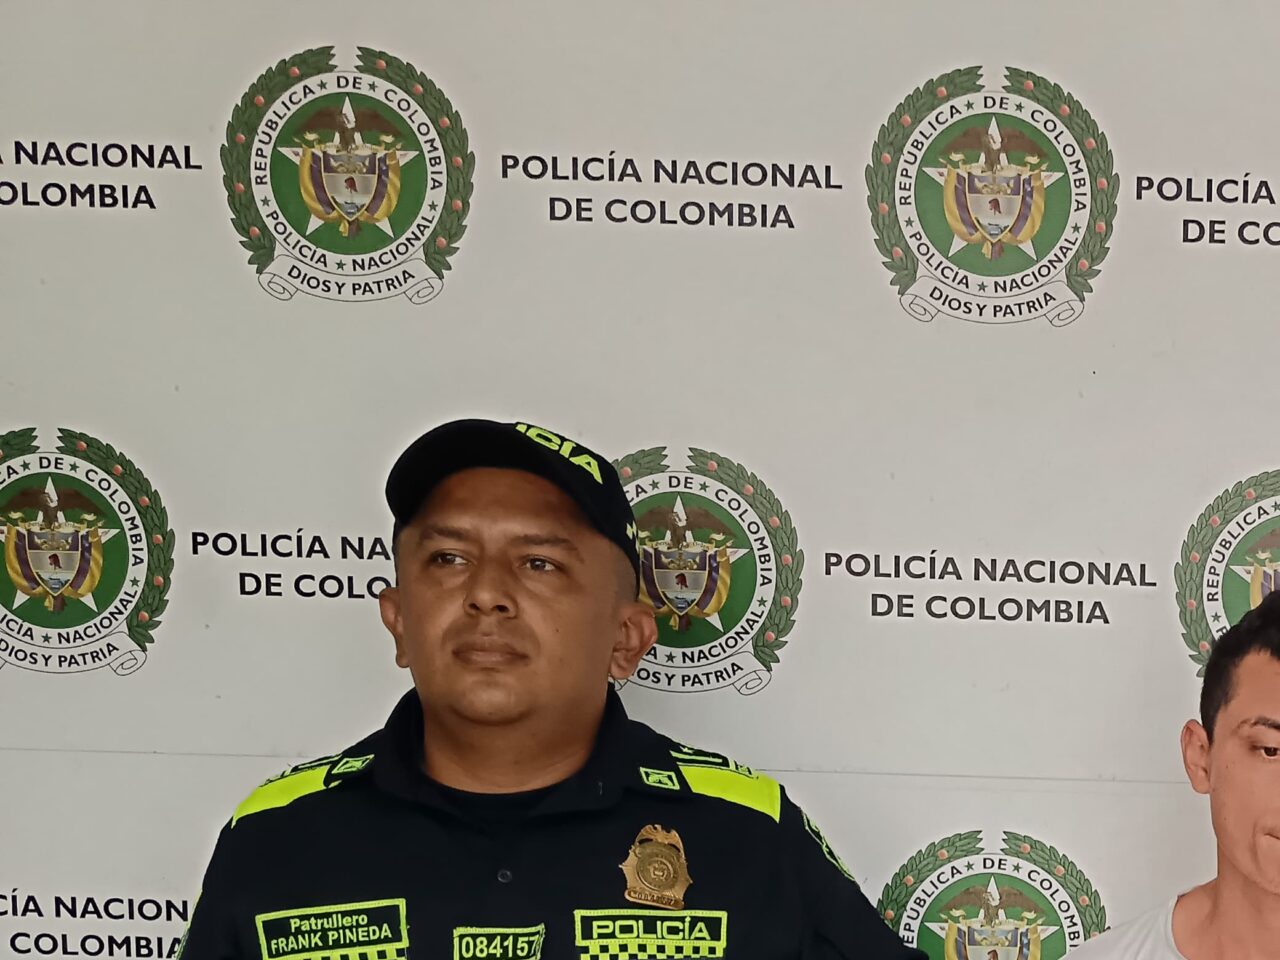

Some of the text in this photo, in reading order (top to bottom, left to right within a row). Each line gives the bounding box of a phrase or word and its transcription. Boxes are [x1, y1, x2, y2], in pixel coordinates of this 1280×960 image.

[337, 76, 362, 89] DE
[384, 89, 442, 190] COLOMBIA
[14, 140, 203, 170] NACIONAL
[501, 150, 843, 190] POLICÍA NACIONAL
[983, 96, 1009, 110] DE
[1030, 109, 1087, 212] COLOMBIA
[0, 181, 157, 210] OLOMBIA
[1136, 172, 1276, 205] POLICÍA
[549, 197, 795, 229] DE COLOMBIA
[266, 211, 436, 271] POLICÍA NACIONAL
[1182, 219, 1226, 244] DE
[909, 232, 1079, 293] POLICÍA NACIONAL
[288, 265, 415, 295] DIOS Y PATRIA
[929, 286, 1057, 317] DIOS Y PATRIA
[39, 457, 144, 566] DE COLOMBIA
[191, 527, 331, 559] POLICÍA
[668, 476, 772, 587] DE COLOMBIA
[824, 549, 1157, 587] POLICÍA NACIONAL
[239, 572, 283, 597] DE
[57, 592, 139, 644] NACIONAL
[871, 593, 1110, 625] DE COLOMBIA
[682, 612, 765, 664] NACIONAL
[41, 654, 52, 666] Y
[58, 643, 119, 667] PATRIA
[665, 673, 675, 685] Y
[681, 662, 744, 687] PATRIA
[54, 895, 189, 922] NACION
[903, 858, 1081, 945] EPÚBLICA DE COLOMB
[270, 923, 393, 955] FRANK PINEDA
[290, 913, 368, 933] Patrullero
[592, 915, 711, 940] POLICÍA
